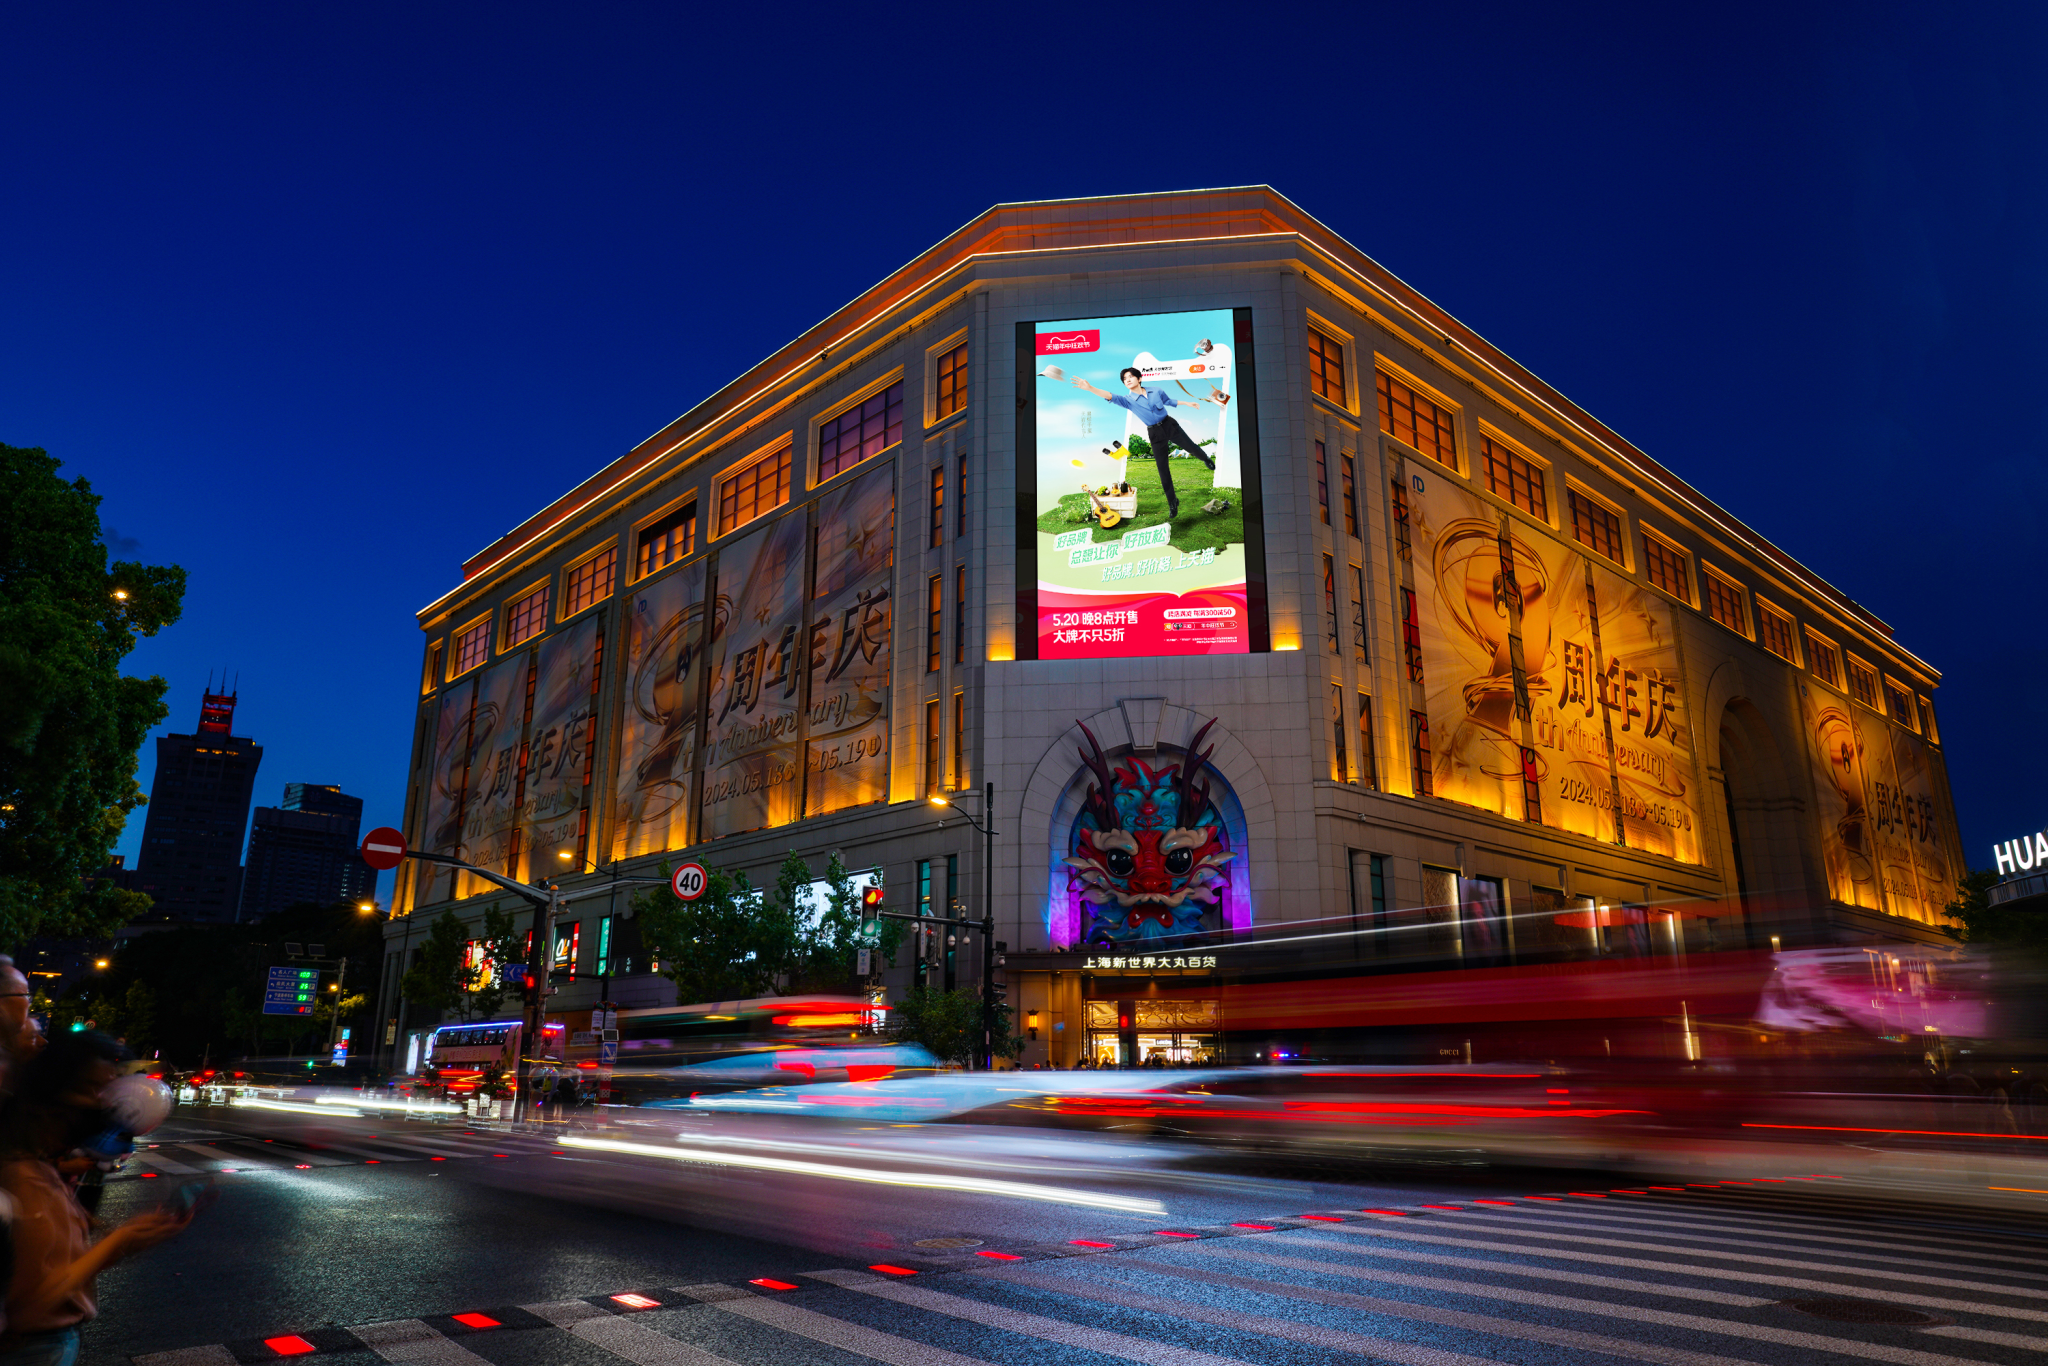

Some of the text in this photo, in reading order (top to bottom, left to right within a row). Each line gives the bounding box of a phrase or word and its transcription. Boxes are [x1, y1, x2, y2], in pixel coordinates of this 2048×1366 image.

[1056, 530, 1088, 549] 好品牌
[1124, 526, 1166, 549] 好放松
[1070, 543, 1119, 565] 总想让你
[1053, 610, 1138, 626] 5.20 晚8点开售
[1053, 627, 1125, 643] 大牌不只5折
[717, 585, 889, 726] 周年庆
[1557, 637, 1677, 746] 周年庆
[484, 708, 589, 806] 周年庆
[1874, 780, 1937, 846] 周年庆
[679, 872, 701, 892] 40
[1082, 956, 1217, 969] 上海新世界大丸百货
